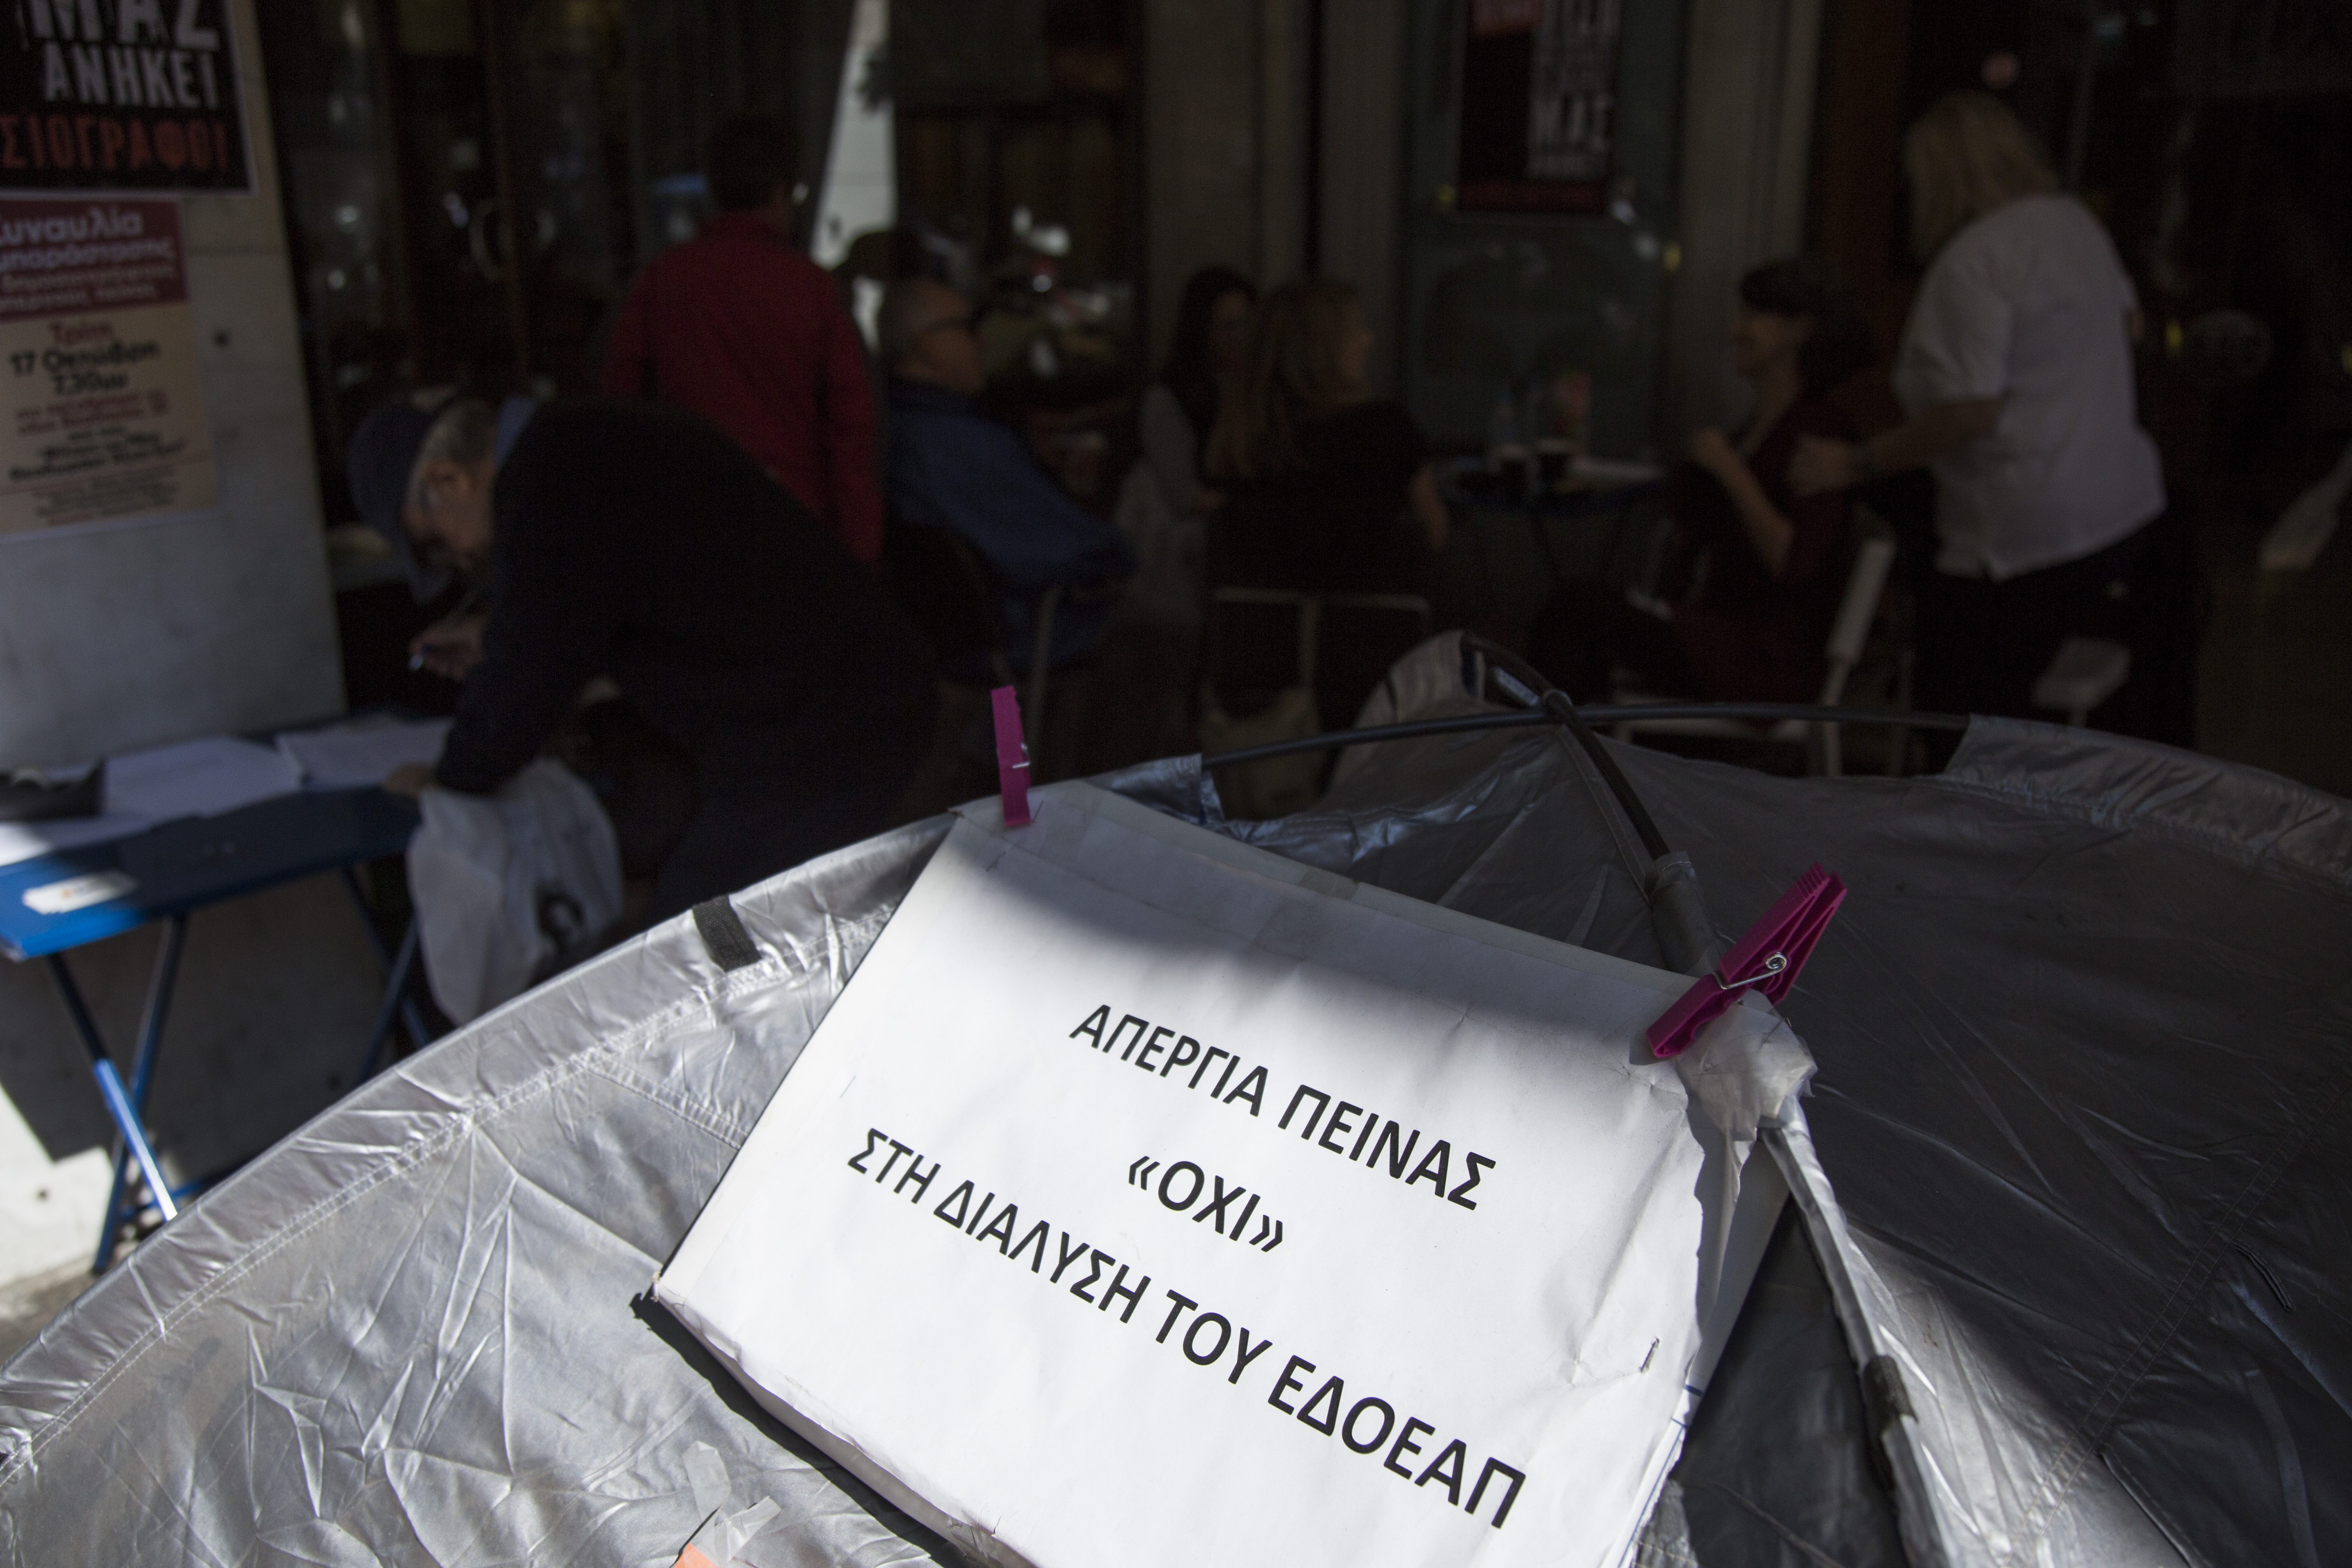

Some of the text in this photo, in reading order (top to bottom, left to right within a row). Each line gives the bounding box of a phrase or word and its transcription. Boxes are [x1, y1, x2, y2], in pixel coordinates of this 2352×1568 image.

[44, 41, 218, 109] ΑΝΗΚΕΙ
[0, 207, 143, 246] υναυλία
[1070, 1005, 1496, 1210] ΑΠΕΡΓΙΑ ΠΕΙΝΑΣ
[1129, 1156, 1282, 1252] «ΟΧΙ»
[849, 1129, 1525, 1528] ΣΤΗ ΔΙΑΛΥΣΗ ΤΟΥ ΕΔΟΕΑΠ
